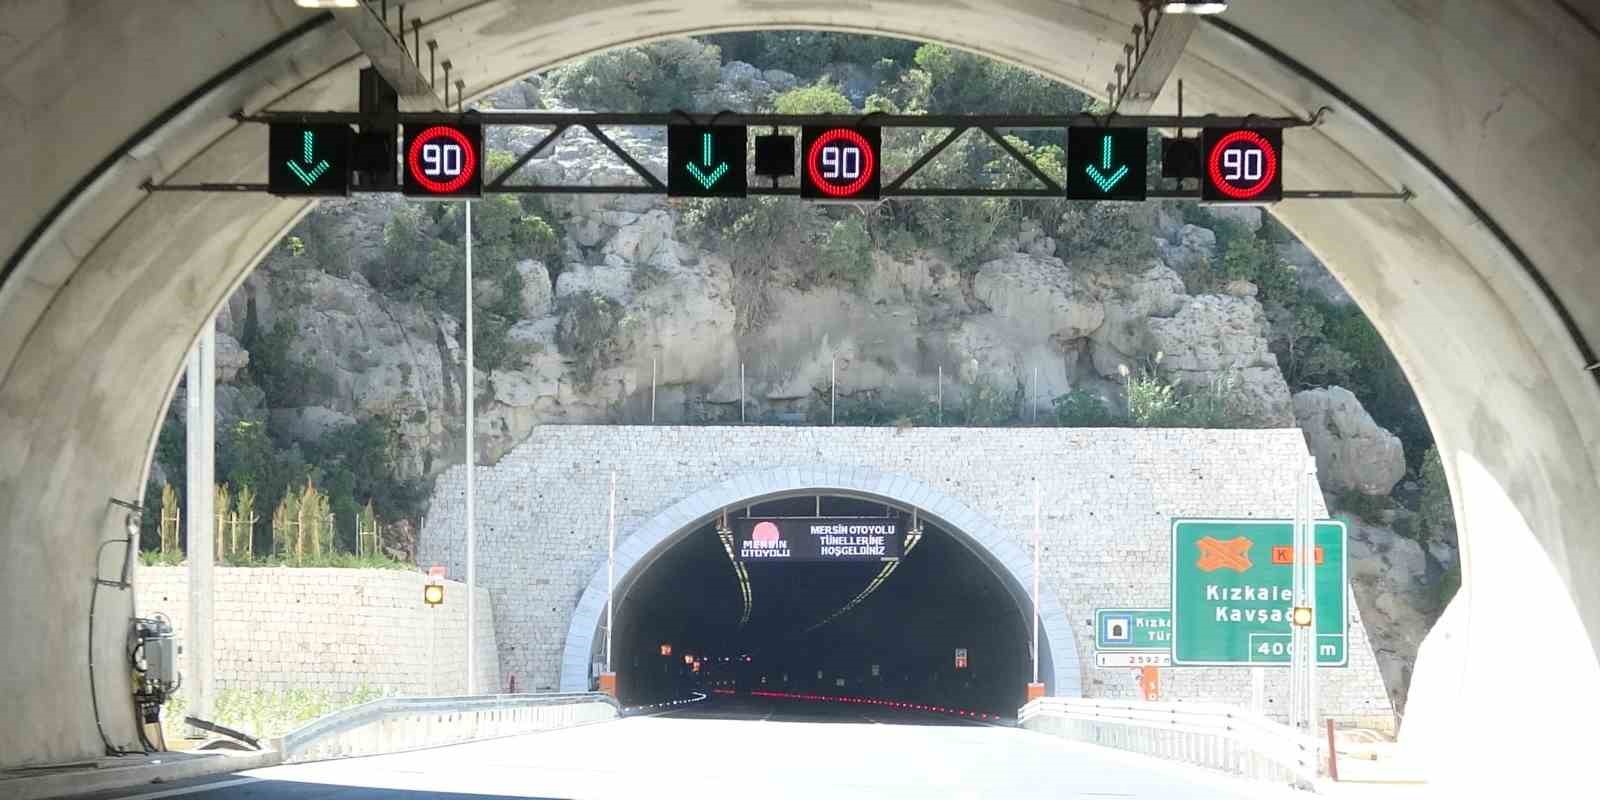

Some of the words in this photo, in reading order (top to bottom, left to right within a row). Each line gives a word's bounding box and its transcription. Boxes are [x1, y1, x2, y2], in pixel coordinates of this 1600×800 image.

[423, 144, 461, 175] 90
[822, 146, 860, 178] 90
[1223, 148, 1262, 180] 90
[849, 525, 895, 535] OTOYOLU
[741, 549, 790, 557] OTOYOLU
[1319, 644, 1337, 656] m
